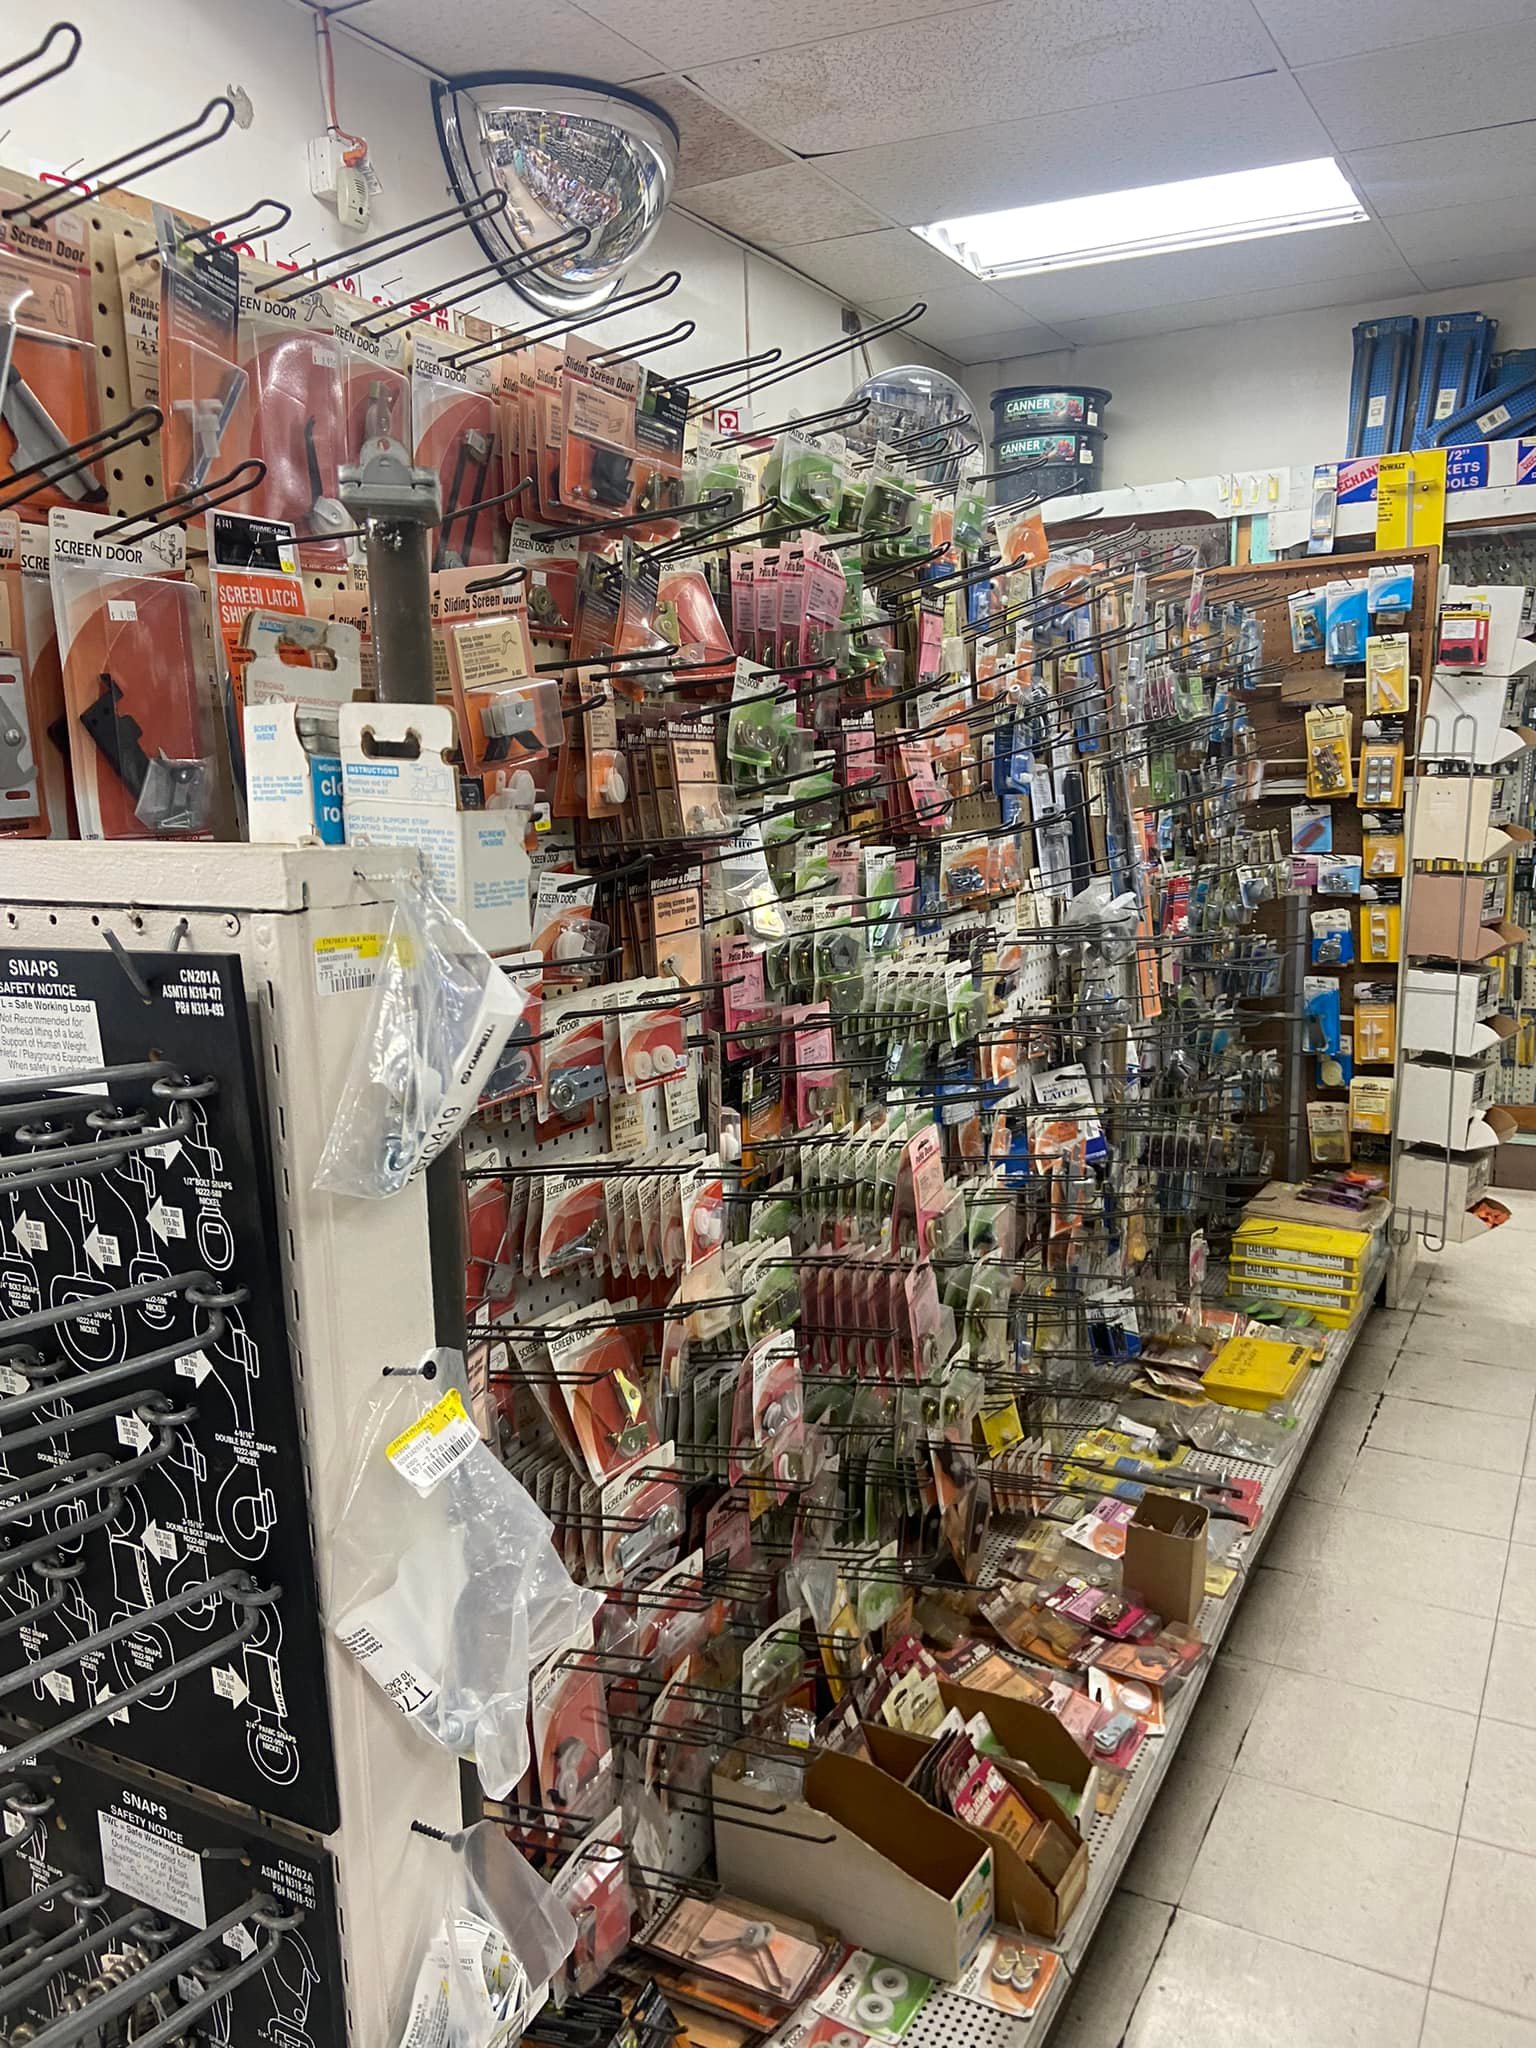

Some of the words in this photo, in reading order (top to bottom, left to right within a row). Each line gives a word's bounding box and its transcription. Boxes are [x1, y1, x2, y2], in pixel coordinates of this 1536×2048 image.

[11, 225, 51, 252] Screen
[56, 240, 86, 262] Door
[264, 300, 297, 320] DOOR
[356, 337, 380, 357] DOOR
[415, 358, 443, 377] SCREEN
[444, 369, 467, 385] DOOR
[537, 368, 557, 388] Sliding
[565, 355, 588, 378] Sliding
[590, 366, 614, 386] Screen
[615, 377, 635, 393] Door
[1006, 399, 1050, 413] CANNER
[1000, 440, 1040, 455] CANNER
[222, 519, 233, 529] 141
[54, 538, 102, 559] SCREEN
[106, 547, 143, 565] DOOR
[512, 537, 533, 551] SCREEN
[534, 540, 554, 554] DOOR
[219, 585, 264, 605] SCREEN
[266, 588, 299, 608] LATCH
[444, 597, 470, 613] Sliding
[472, 594, 500, 609] Screen
[668, 720, 692, 734] Window
[693, 724, 698, 734] &
[698, 724, 715, 735] Door
[348, 766, 398, 776] INSTRUCTIONS
[650, 877, 677, 889] Window
[539, 893, 559, 904] SCREEN
[560, 892, 577, 904] DOOR
[728, 952, 743, 962] Patio
[9, 959, 59, 977] SNAPS
[179, 969, 221, 985] CN201A
[38, 983, 77, 997] NOTICE
[15, 999, 33, 1010] Safe
[34, 1001, 68, 1014] Working
[70, 1003, 91, 1013] Load
[14, 1013, 70, 1026] Recommended
[562, 1019, 580, 1033] DOOR
[1, 1025, 33, 1036] Overhead
[35, 1027, 53, 1039] lifting
[54, 1029, 60, 1038] of
[1, 1036, 28, 1047] Support
[29, 1038, 35, 1047] of
[37, 1039, 60, 1049] Human
[468, 1025, 493, 1069] CAMPBELL
[23, 1049, 60, 1062] Playground
[8, 1060, 28, 1070] When
[30, 1062, 49, 1074] safety
[211, 1180, 233, 1190] SNAPS
[546, 1182, 567, 1197] SCREEN
[199, 1197, 221, 1207] NICKEL
[146, 1304, 166, 1314] NICKEL
[79, 1325, 99, 1336] NICKEL
[518, 1341, 544, 1360] SCREEN
[551, 1334, 575, 1353] SCREEN
[214, 1433, 239, 1446] DOUBLE
[239, 1438, 255, 1449] BOLT
[256, 1442, 277, 1454] SNAPS
[237, 1457, 259, 1468] NICKEL
[604, 1486, 629, 1514] SCREEN
[166, 1521, 188, 1534] DOUBLE
[189, 1526, 203, 1538] BOLT
[204, 1531, 224, 1544] SNAPS
[187, 1543, 207, 1555] NICKEL
[128, 1642, 144, 1653] PANIC
[144, 1647, 163, 1659] SNAPS
[134, 1659, 153, 1671] NICKEL
[259, 1725, 276, 1737] PANIC
[276, 1730, 297, 1744] SNAPS
[262, 1741, 284, 1755] NICKEL
[122, 1790, 168, 1821] SNAPS
[110, 1804, 146, 1828] SAFETY
[148, 1821, 184, 1844] NOTICE
[127, 1825, 142, 1837] Safe
[145, 1831, 175, 1855] Working
[177, 1847, 195, 1862] Load
[278, 1859, 314, 1884] CN202A
